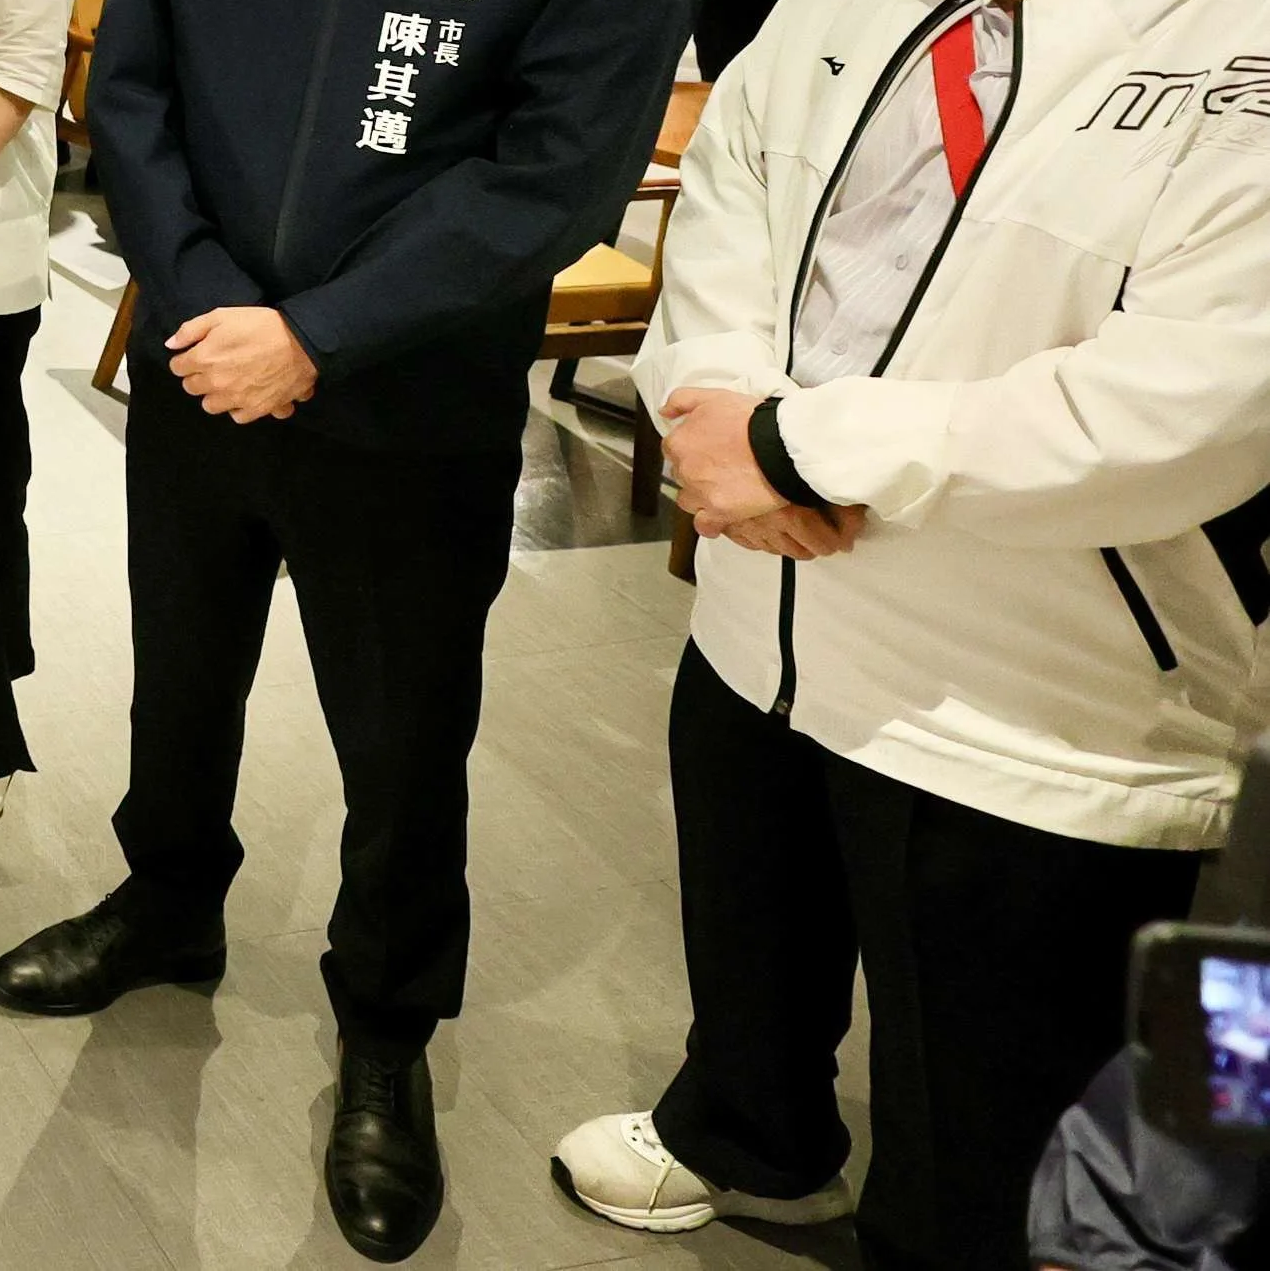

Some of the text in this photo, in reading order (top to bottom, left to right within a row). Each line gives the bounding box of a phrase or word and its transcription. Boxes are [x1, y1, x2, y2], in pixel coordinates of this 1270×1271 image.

[356, 11, 431, 156] 陳其邁
[433, 19, 465, 67] 市長
